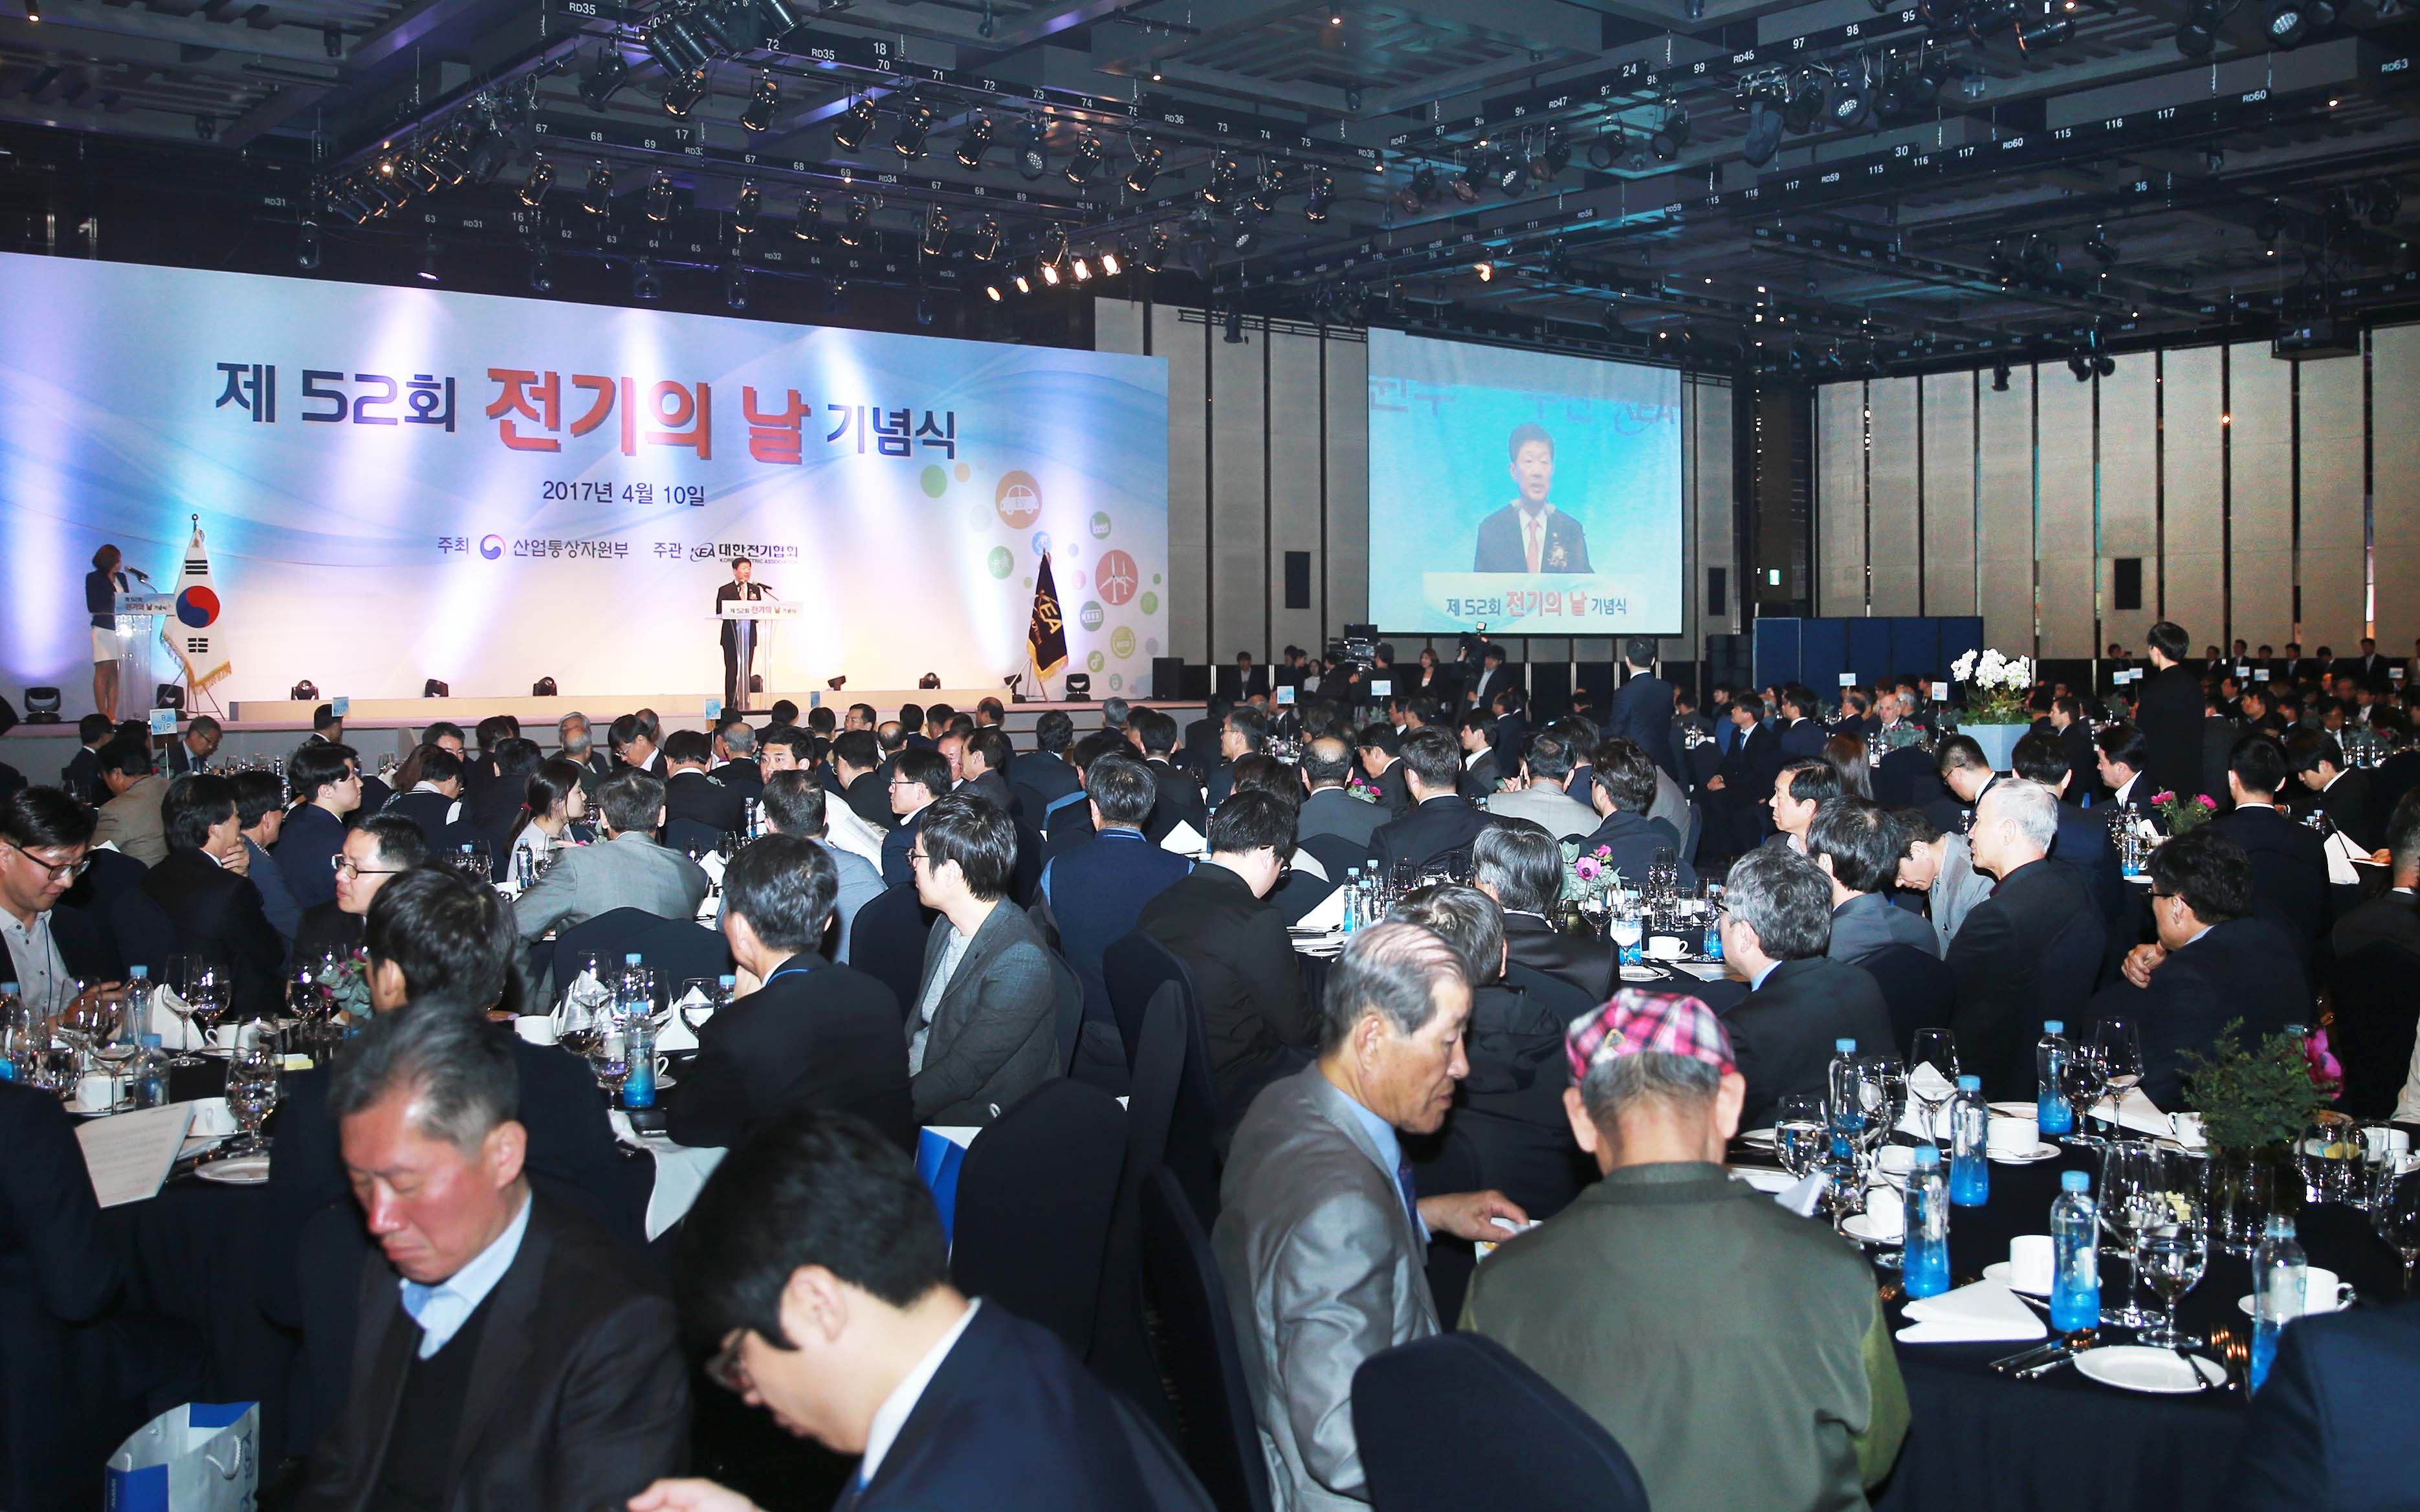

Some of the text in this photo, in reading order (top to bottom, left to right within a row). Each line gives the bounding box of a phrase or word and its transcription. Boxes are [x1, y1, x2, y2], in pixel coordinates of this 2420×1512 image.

[569, 2, 596, 15] RD35
[1902, 10, 1915, 23] 99
[1847, 24, 1858, 36] 98
[766, 38, 779, 50] 72
[1793, 37, 1805, 49] 97
[873, 42, 886, 55] 18
[811, 48, 835, 60] RD35
[1733, 50, 1754, 64] RD46
[877, 60, 890, 70] 70
[1623, 63, 1636, 77] 24
[1694, 63, 1705, 74] 99
[2381, 58, 2408, 72] RD63
[932, 70, 943, 80] 71
[984, 80, 996, 91] 72
[1033, 90, 1044, 100] 73
[2243, 90, 2267, 104] RD60
[1081, 98, 1092, 107] 74
[1549, 96, 1567, 109] RD47
[2157, 108, 2175, 119] 117
[1165, 114, 1184, 124] RD36
[2106, 118, 2122, 129] 116
[536, 124, 547, 133] 67
[1218, 122, 1227, 132] 73
[1436, 126, 1445, 135] 97
[590, 131, 602, 141] 68
[675, 129, 689, 140] 17
[1260, 130, 1270, 139] 74
[2054, 128, 2071, 139] 115
[644, 139, 655, 149] 69
[1301, 138, 1311, 147] 75
[1391, 135, 1407, 146] RD47
[2003, 138, 2023, 149] RD60
[1358, 149, 1375, 159] RD36
[1895, 145, 1908, 157] 30
[1959, 147, 1974, 158] 117
[745, 155, 756, 163] 67
[1913, 156, 1928, 166] 116
[794, 162, 804, 171] 68
[1869, 164, 1884, 175] 115
[841, 168, 851, 177] 69
[879, 175, 897, 184] RD34
[1821, 173, 1840, 183] RD59
[932, 181, 941, 190] 67
[1786, 181, 1799, 190] 117
[2135, 181, 2147, 192] 36
[975, 187, 984, 195] 68
[1745, 189, 1759, 198] 116
[265, 197, 285, 206] RD31
[1017, 193, 1026, 201] 69
[1666, 203, 1682, 213] RD59
[425, 215, 435, 223] 63
[512, 212, 524, 222] 16
[463, 220, 483, 228] RD31
[1527, 221, 1538, 230] 111
[519, 225, 529, 234] 61
[607, 235, 617, 243] 63
[649, 239, 659, 248] 64
[691, 244, 701, 252] 65
[811, 256, 820, 265] 64
[216, 362, 958, 465] 제 52회 전기의 날 기념식
[543, 481, 705, 507] 2017년 4월 10일
[437, 537, 628, 559] 주최 산업통상자원부
[654, 542, 798, 559] 주관 KEA 대한전기협회
[1446, 591, 1627, 617] 제 52회 전기의 날 기념식
